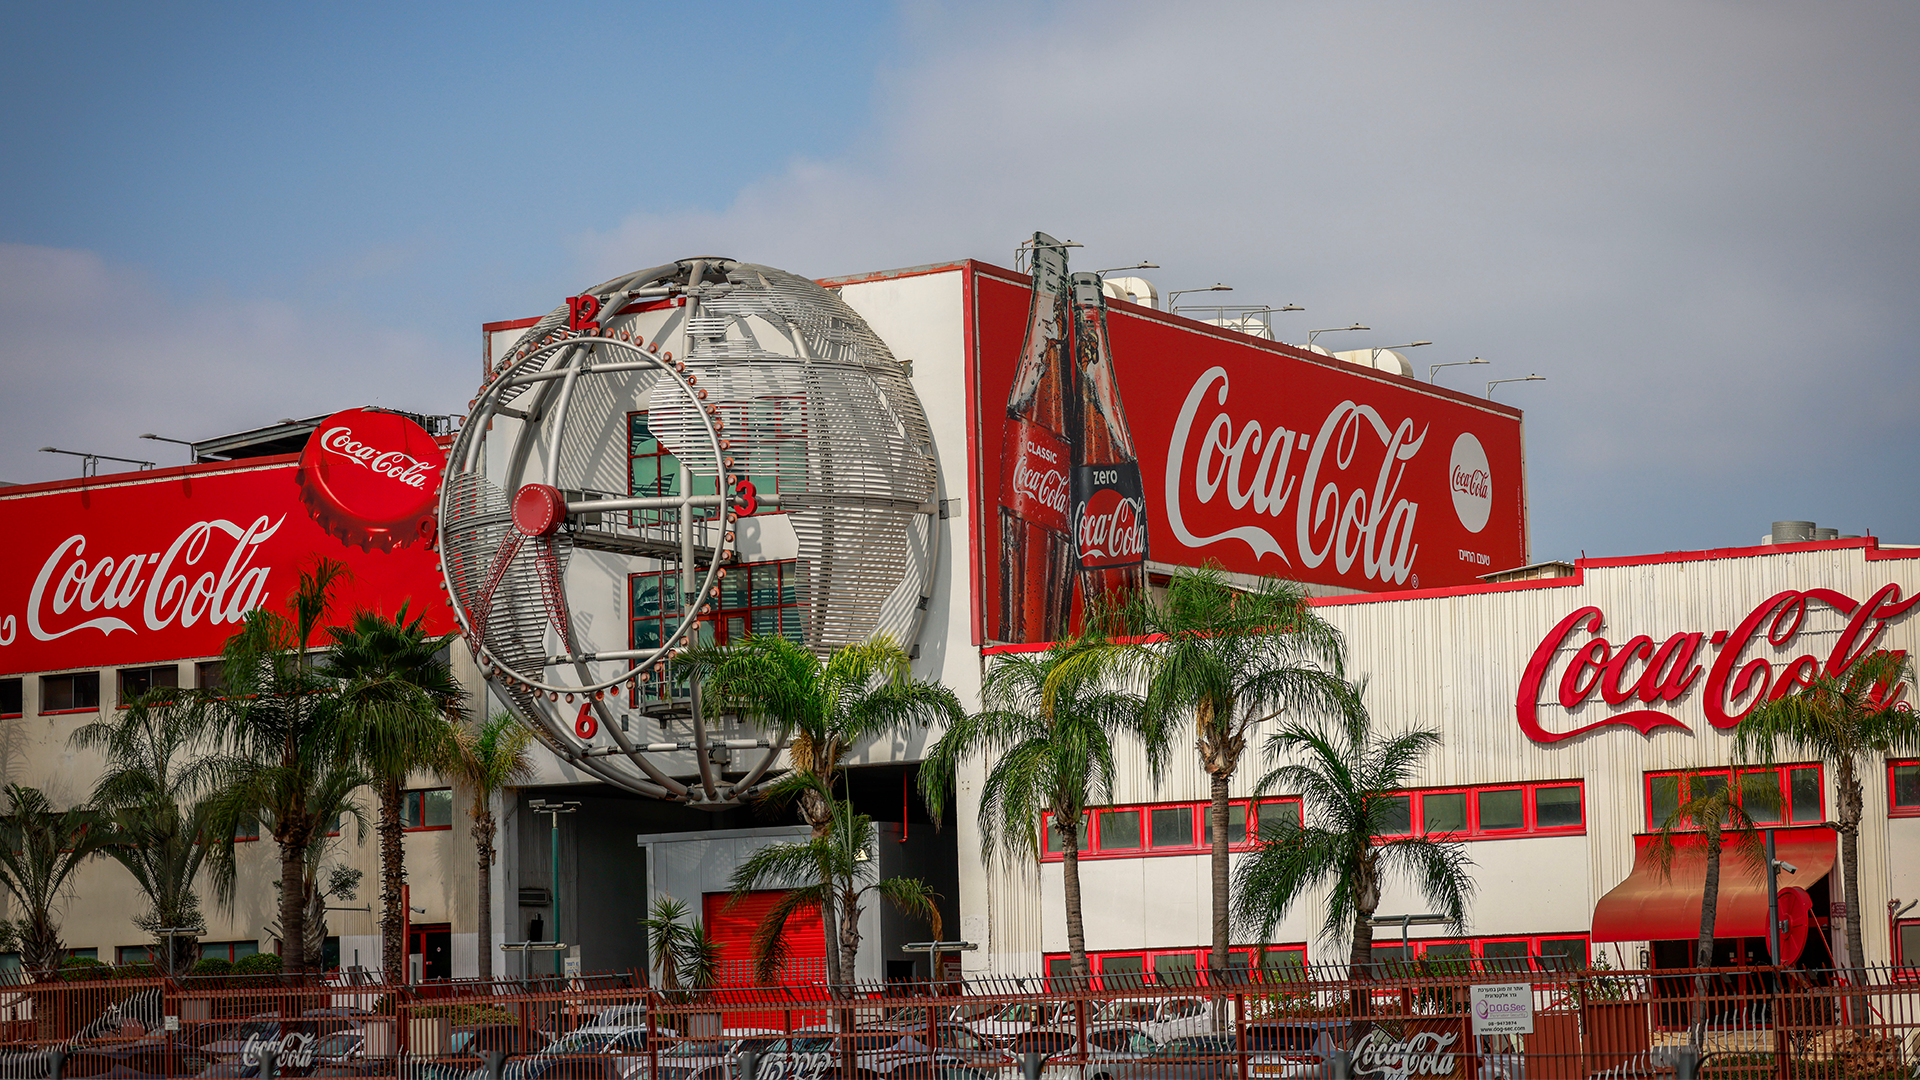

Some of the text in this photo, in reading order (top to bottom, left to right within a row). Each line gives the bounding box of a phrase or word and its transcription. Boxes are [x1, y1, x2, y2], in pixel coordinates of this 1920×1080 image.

[566, 294, 600, 331] 12
[321, 426, 437, 489] Coca-Cola
[1027, 441, 1057, 465] CLASSIC
[1013, 455, 1070, 514] Coca-Cola
[1093, 470, 1118, 485] zero
[1166, 366, 1429, 586] Coca-Cola
[1452, 464, 1489, 499] Coca-Cola
[733, 480, 758, 517] 3
[1073, 497, 1146, 559] Coca-Cola
[27, 512, 287, 642] Coca-Cola
[575, 703, 598, 739] 6
[1351, 1031, 1459, 1076] Coca-Cola
